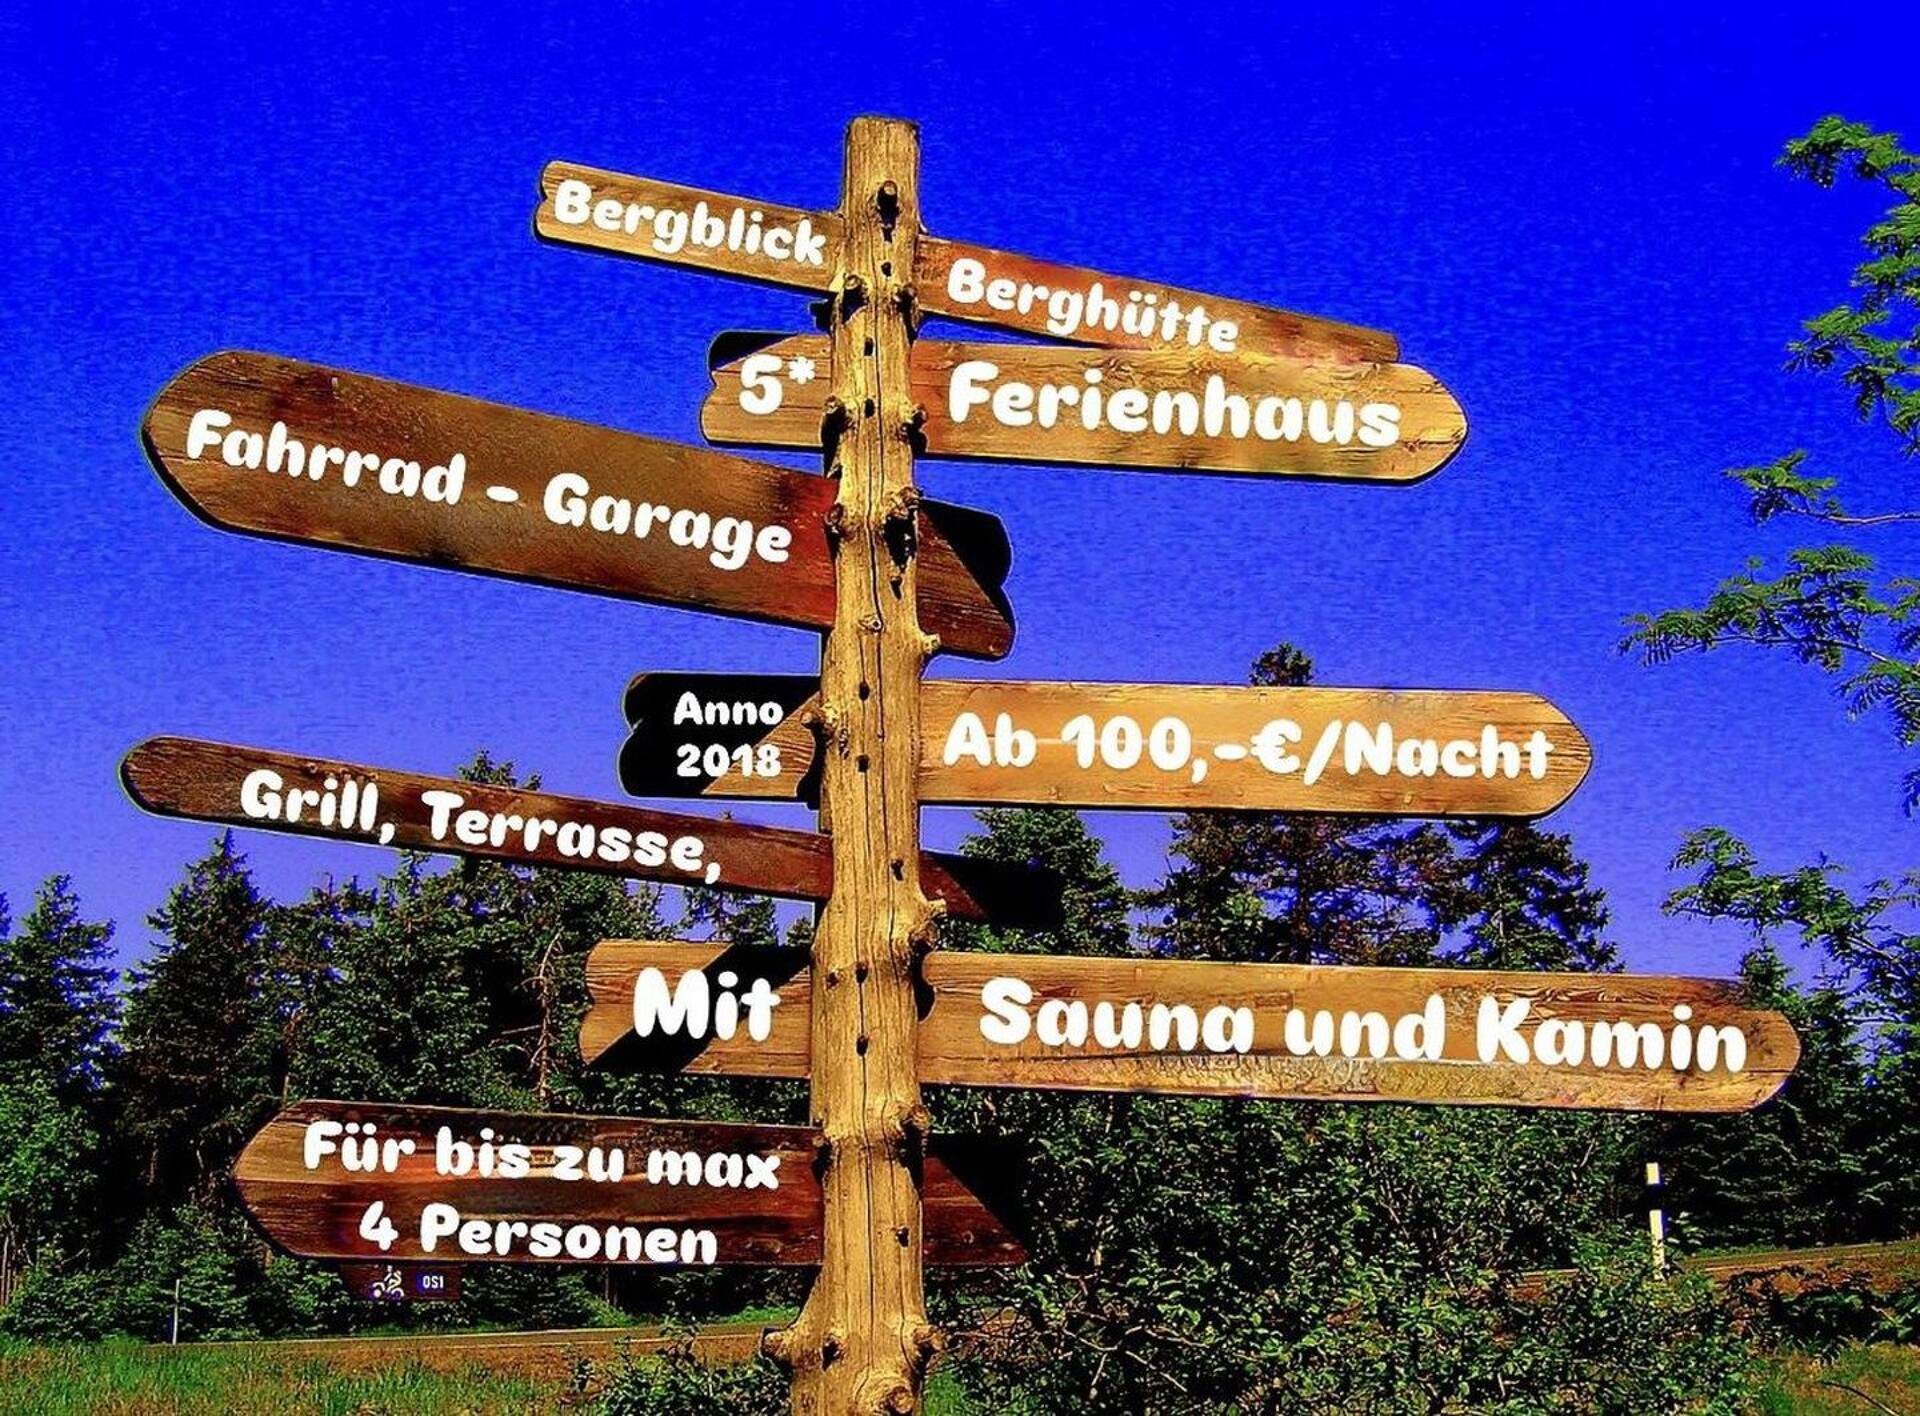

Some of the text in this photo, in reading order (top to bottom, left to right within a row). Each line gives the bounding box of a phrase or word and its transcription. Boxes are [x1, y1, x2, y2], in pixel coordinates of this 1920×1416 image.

[555, 180, 825, 265] Bergblick
[948, 259, 1239, 352] Berghütte
[950, 361, 1400, 446] Ferienhaus
[187, 409, 793, 571] Fahrrad - Garage
[674, 691, 783, 726] Anno
[944, 712, 1035, 767] Ab
[677, 743, 782, 778] 2018
[241, 769, 721, 885] Grill, Terrasse,
[634, 969, 1747, 1072] Mit Sauna und Kamin
[304, 1120, 781, 1189] Für bis zu max
[359, 1201, 718, 1265] 4 Personen
